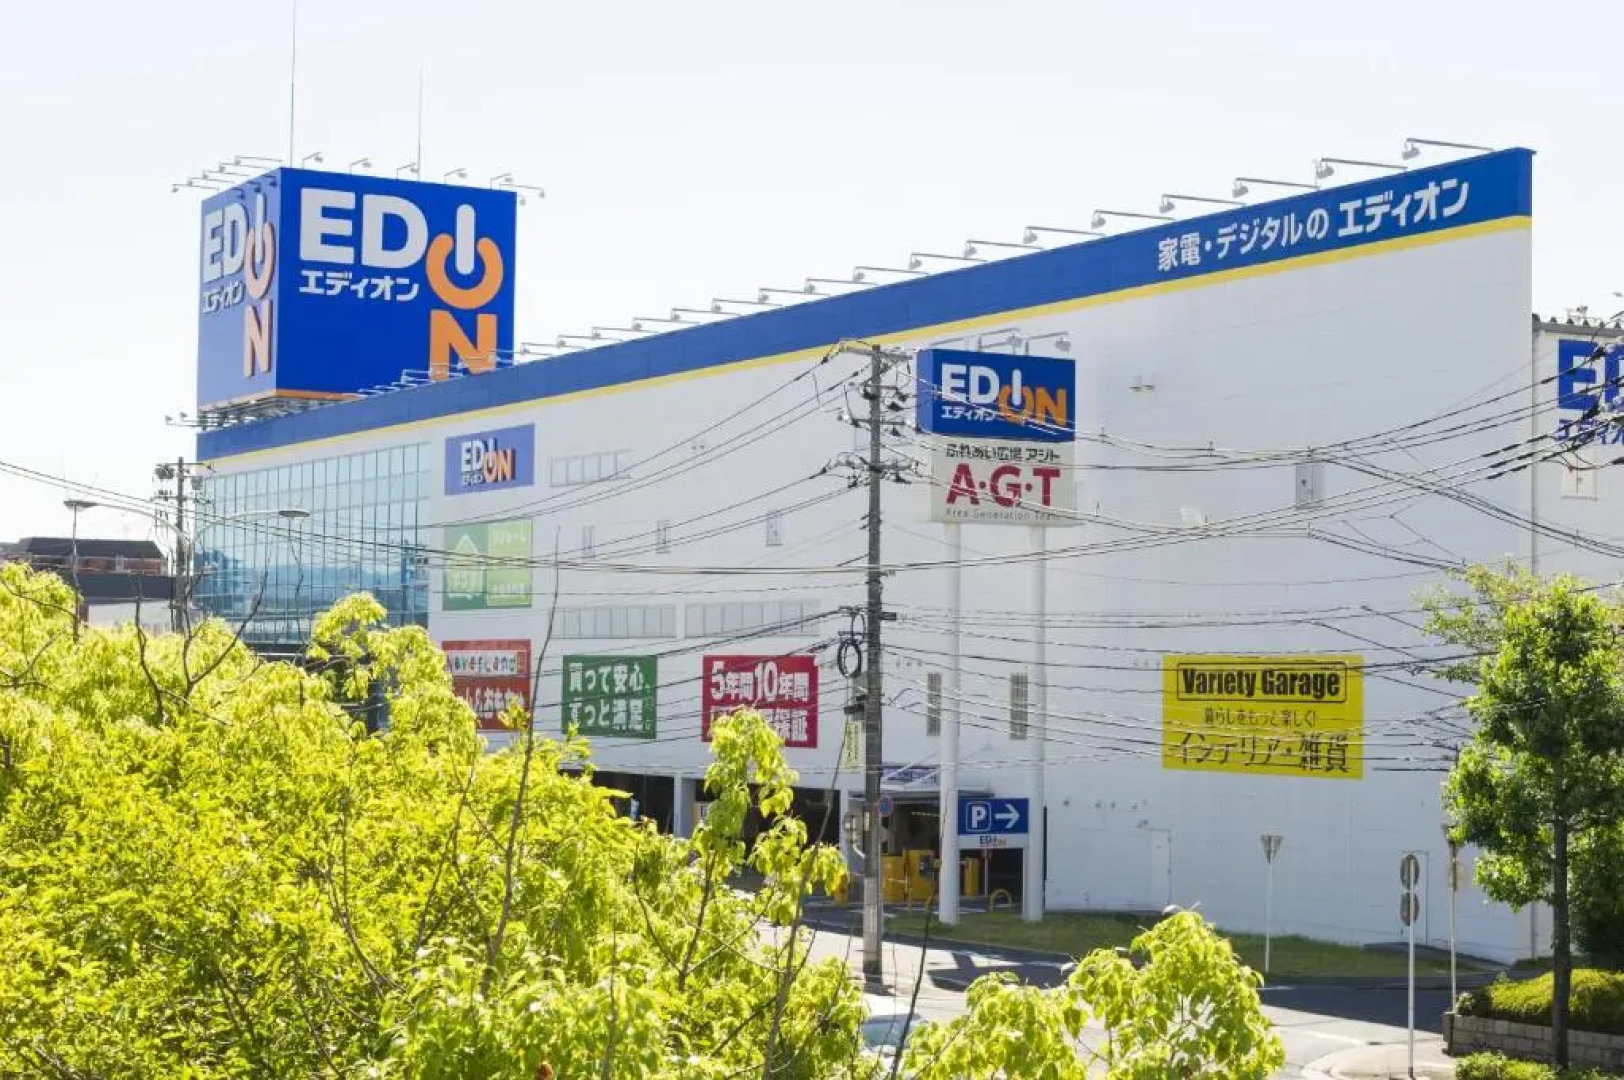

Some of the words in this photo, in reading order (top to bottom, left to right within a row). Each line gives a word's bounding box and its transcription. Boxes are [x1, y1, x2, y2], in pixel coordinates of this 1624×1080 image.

[1337, 178, 1471, 237] エディオン
[299, 268, 420, 302] エディオン
[941, 363, 1067, 427] EDION
[461, 438, 512, 483] EDION
[1182, 667, 1257, 697] Variety
[1261, 669, 1340, 699] Garage
[971, 805, 987, 829] P
